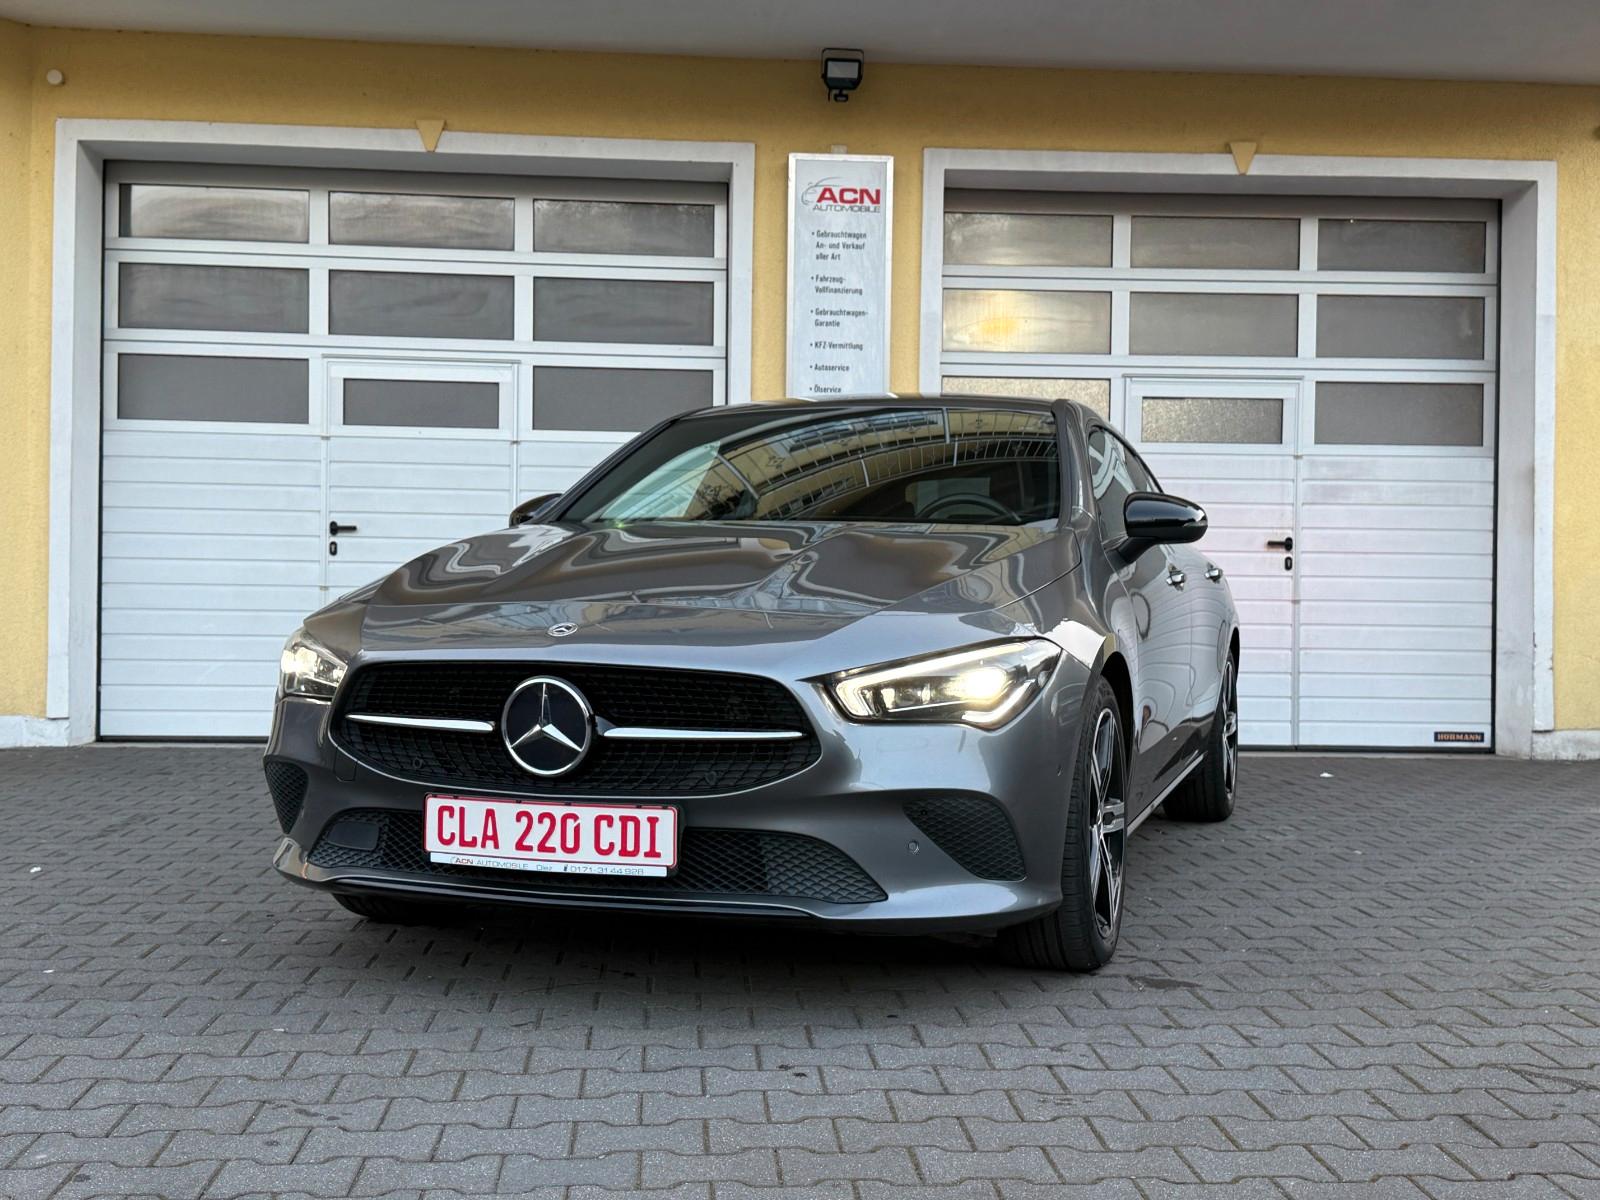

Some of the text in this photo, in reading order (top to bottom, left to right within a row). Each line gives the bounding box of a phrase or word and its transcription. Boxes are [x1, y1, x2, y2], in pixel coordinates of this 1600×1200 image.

[816, 187, 880, 205] ACN
[813, 204, 880, 213] AUTOMOBILE
[816, 230, 867, 240] Gebrauchtwagen
[816, 241, 826, 249] An-
[842, 242, 865, 250] Verkauf
[816, 252, 829, 260] aller
[815, 274, 846, 284] Fahrzeug-
[814, 286, 863, 296] Vollfinanzierung
[815, 308, 868, 318] Gebrauchtwagen-
[814, 319, 840, 327] Garantie
[814, 363, 850, 371] Autoservice
[814, 384, 841, 393] Ölservice
[437, 804, 662, 859] CLA 220 CDI
[455, 857, 474, 865] ACN
[476, 859, 529, 870] AUTOMOBILE
